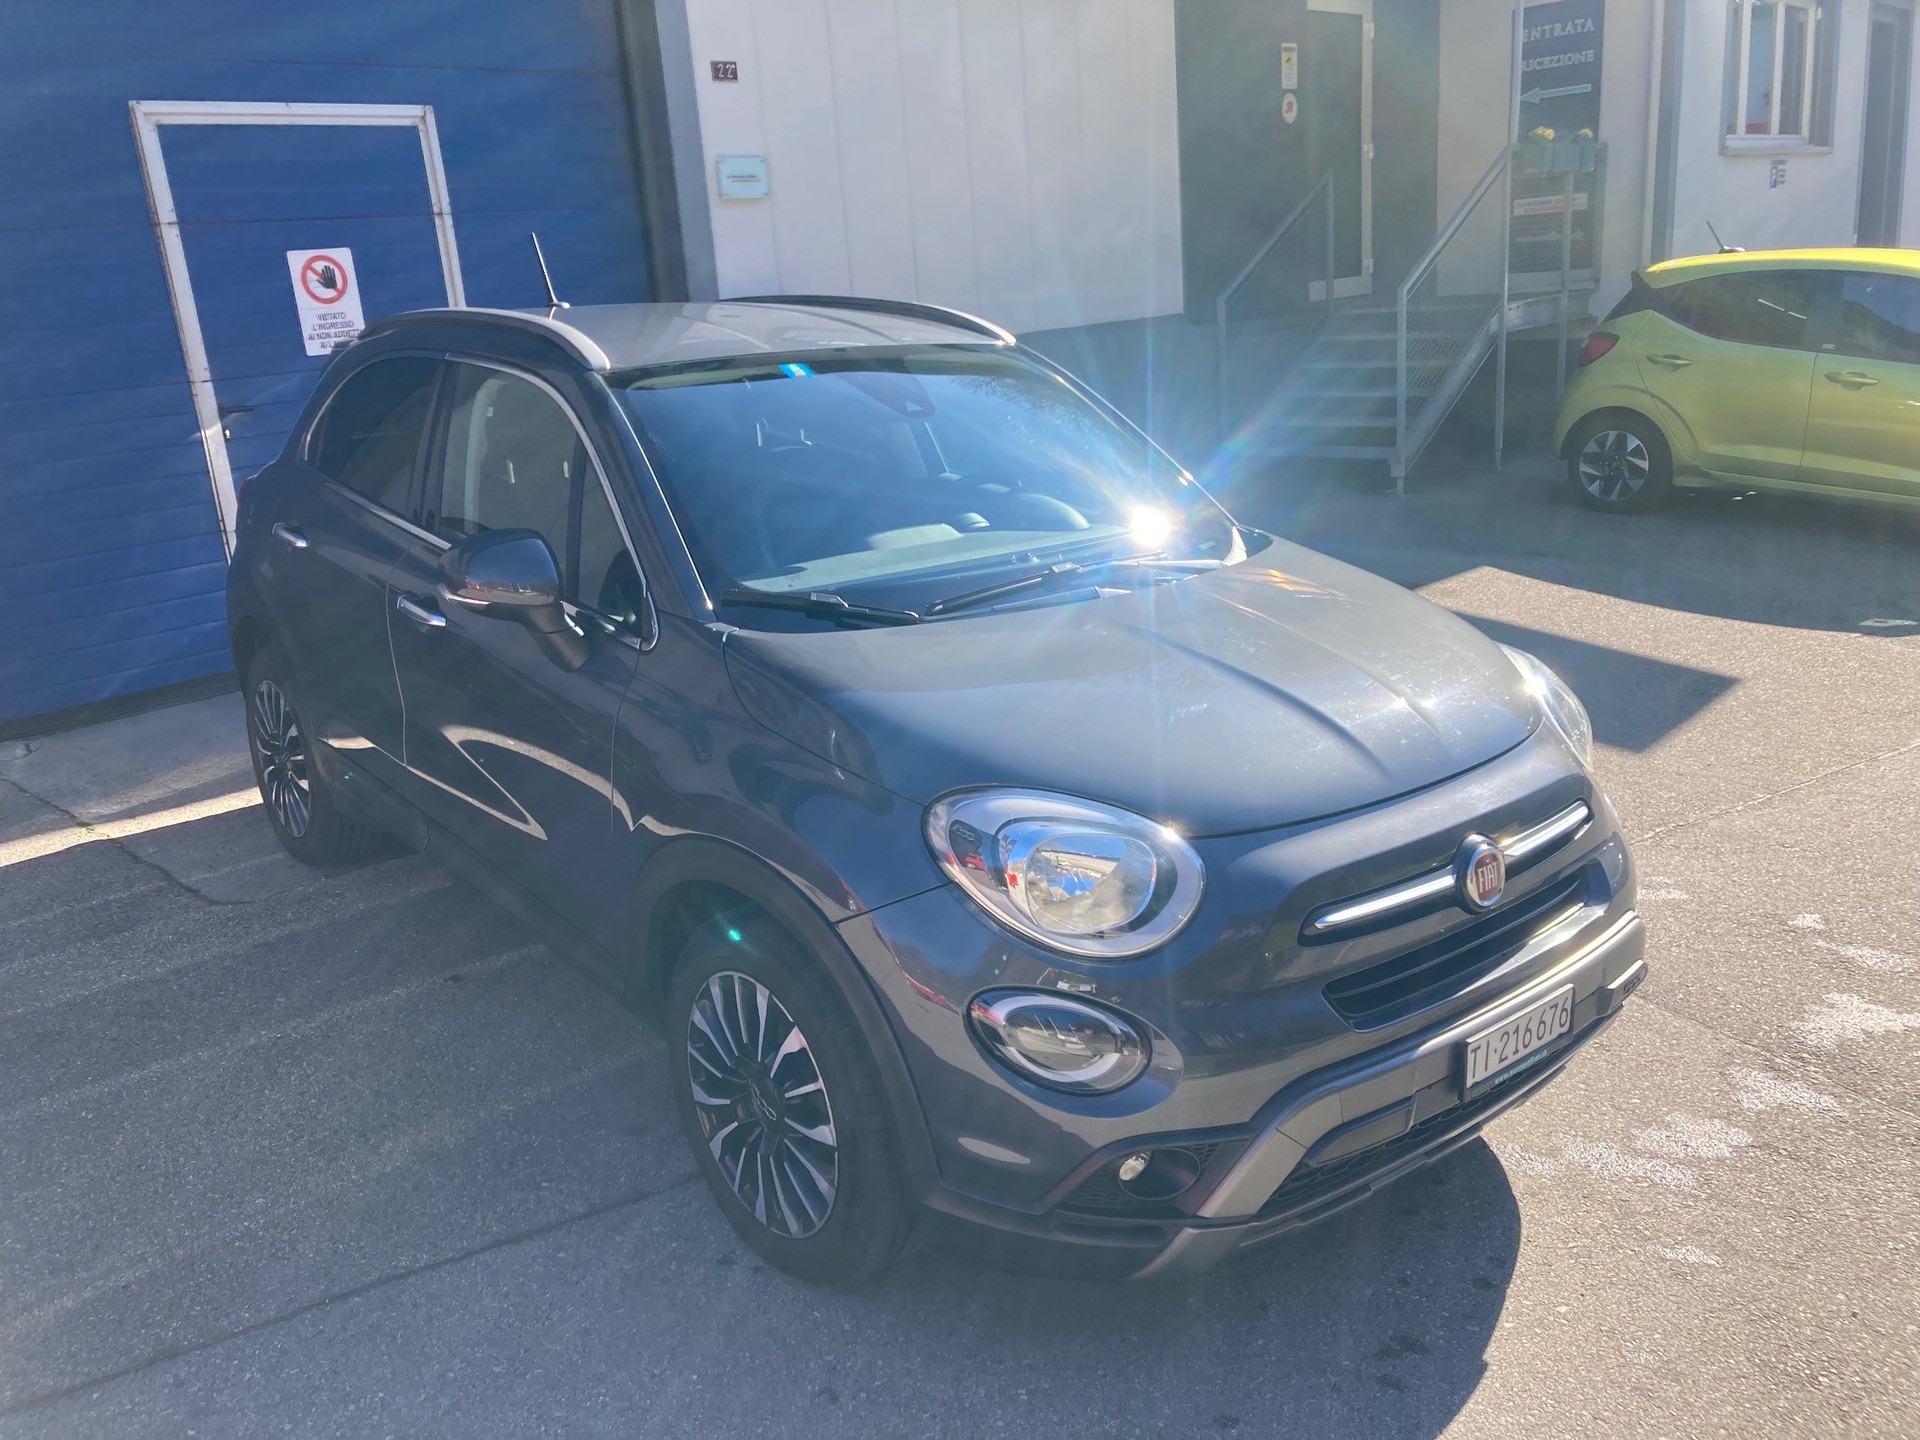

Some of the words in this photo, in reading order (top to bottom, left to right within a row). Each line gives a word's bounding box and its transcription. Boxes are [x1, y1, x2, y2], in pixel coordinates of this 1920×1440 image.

[1522, 18, 1595, 42] ENTRATA
[1521, 50, 1594, 71] RICEZIONE
[717, 63, 736, 79] 22
[316, 312, 347, 321] VIETATO
[317, 331, 332, 340] NON
[1477, 861, 1498, 893] FIAT
